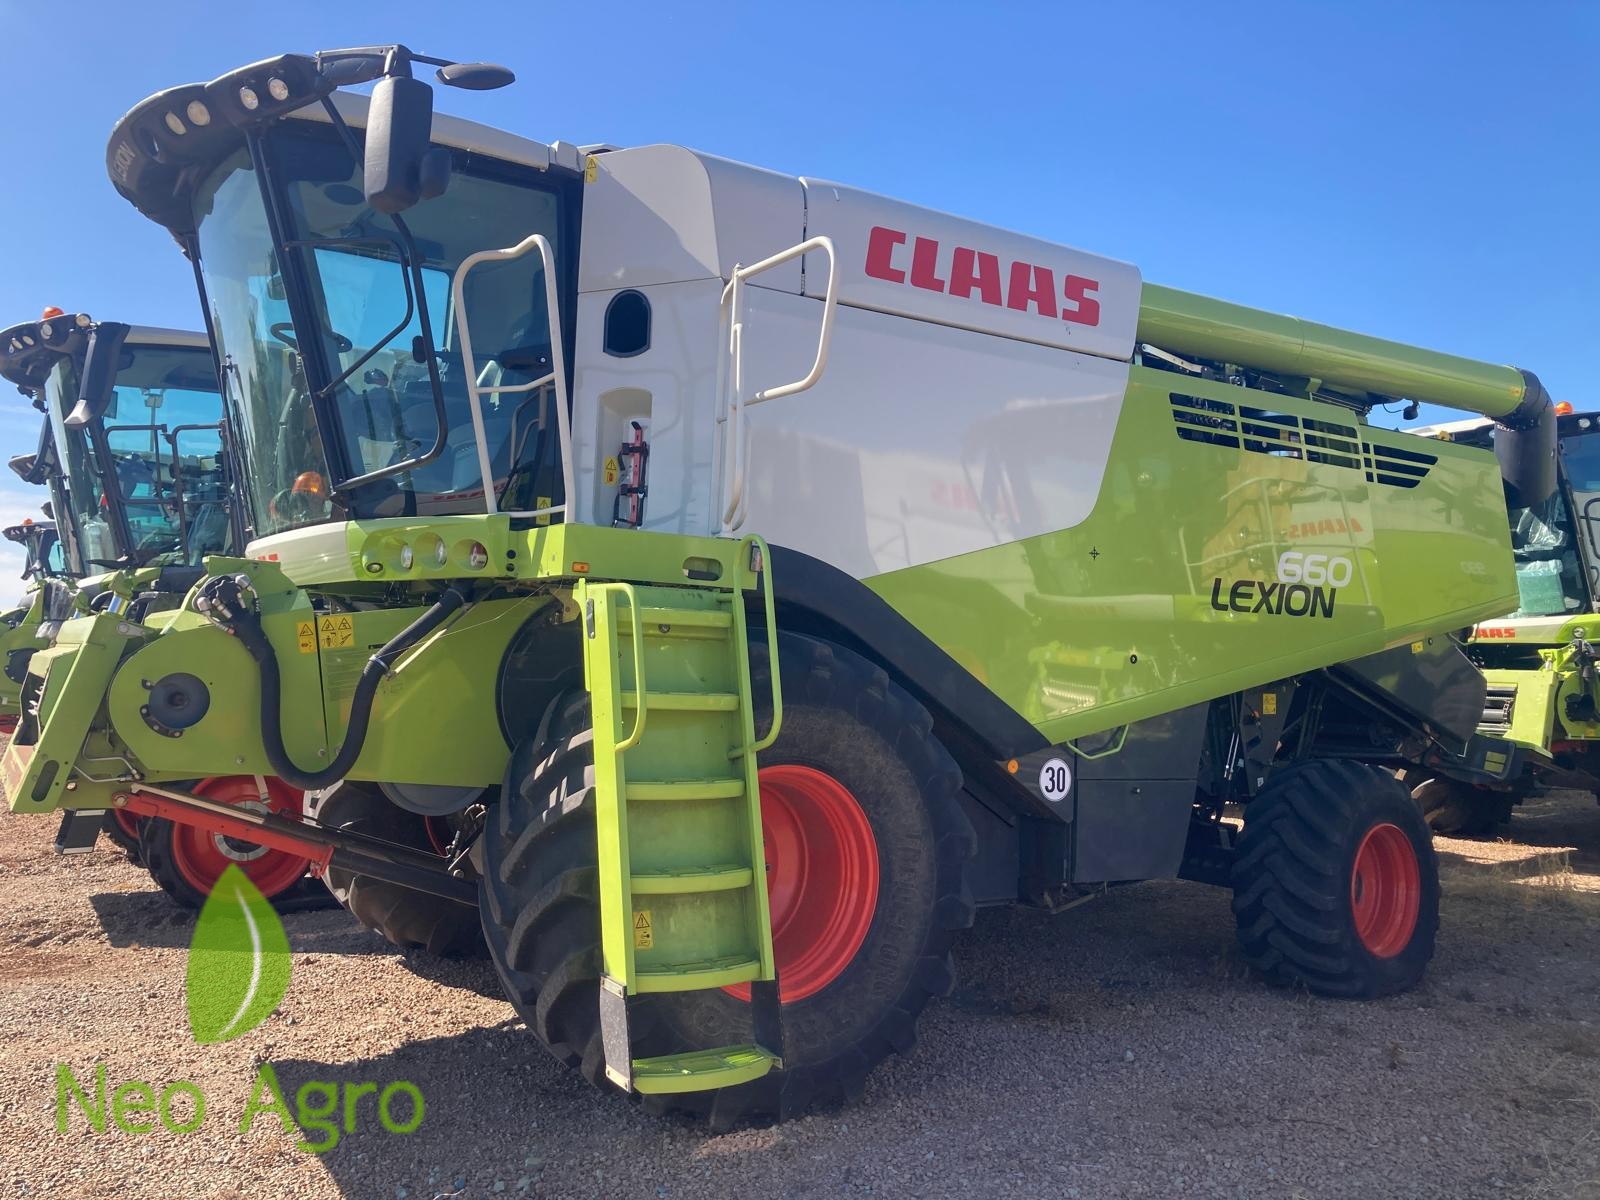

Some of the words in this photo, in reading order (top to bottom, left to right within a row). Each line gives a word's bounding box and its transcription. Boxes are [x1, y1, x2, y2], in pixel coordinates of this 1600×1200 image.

[865, 226, 1100, 327] CLAAS
[1277, 551, 1353, 588] 660
[1210, 577, 1337, 619] LEXION
[1044, 766, 1066, 793] 30
